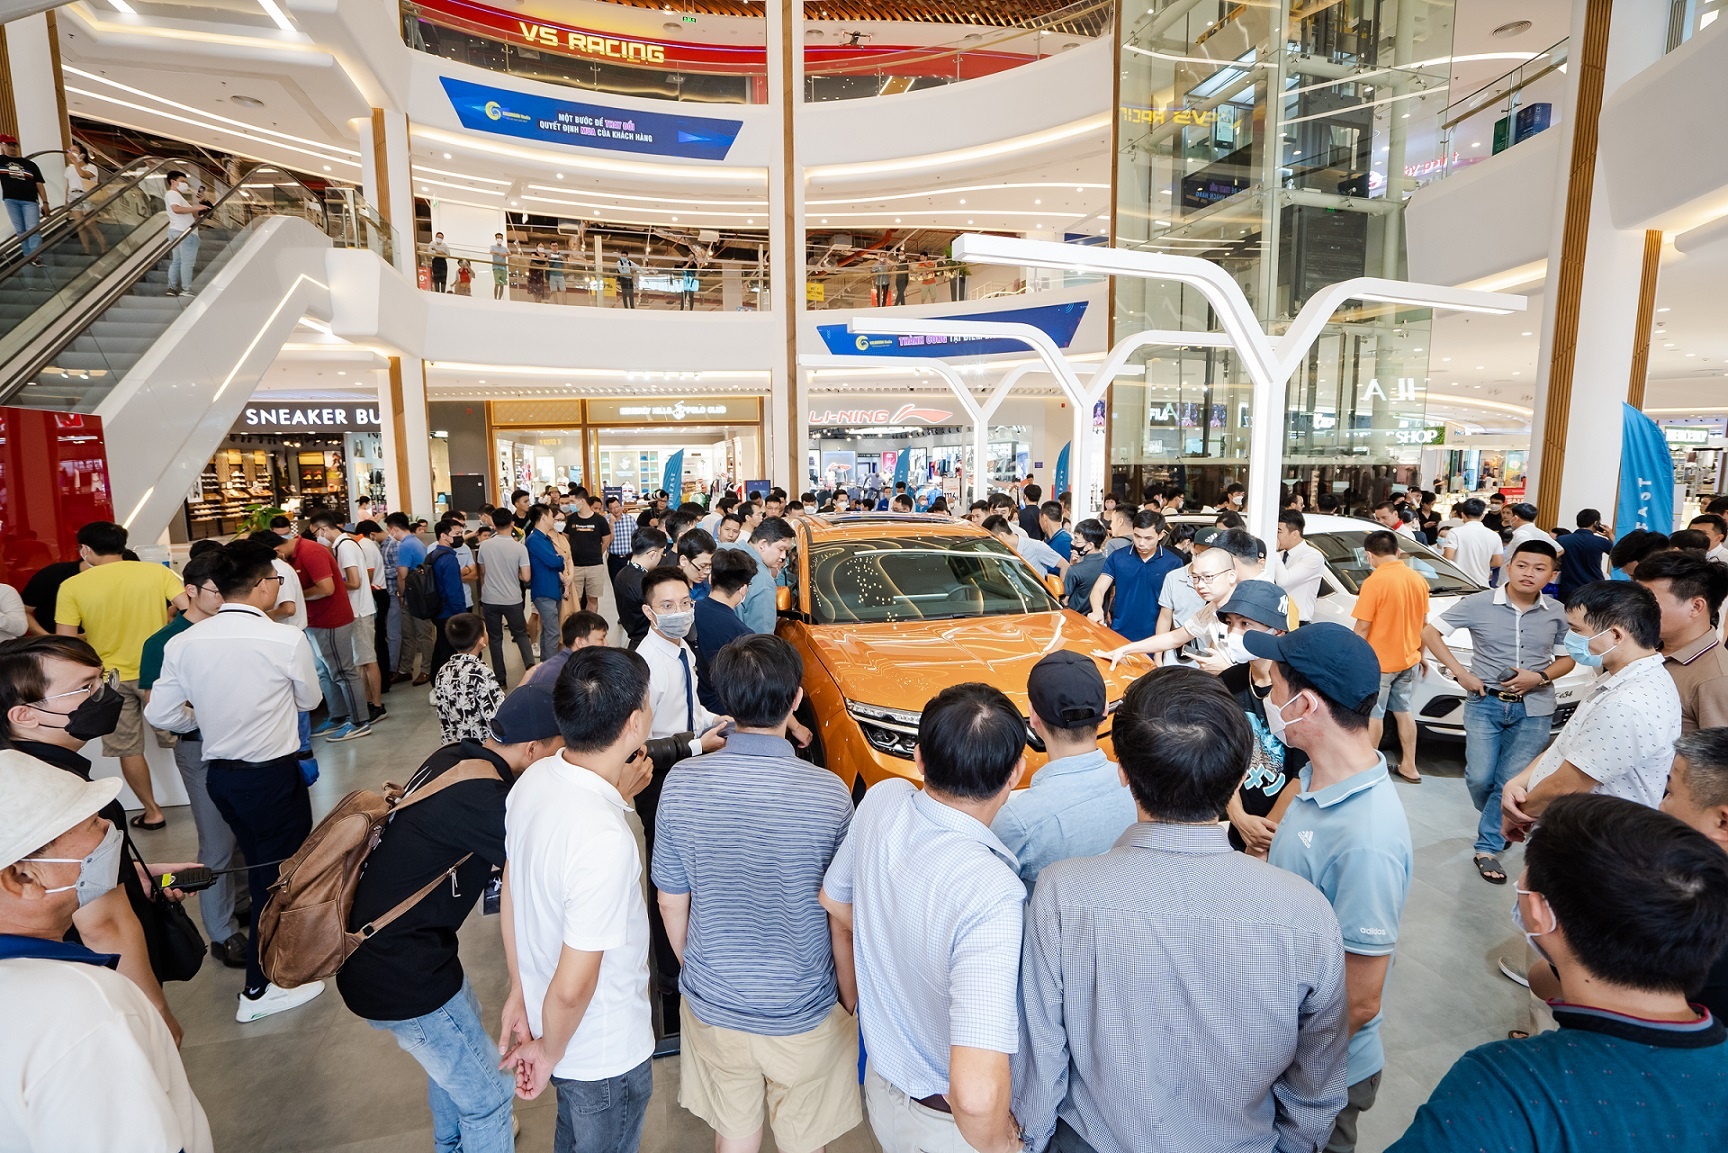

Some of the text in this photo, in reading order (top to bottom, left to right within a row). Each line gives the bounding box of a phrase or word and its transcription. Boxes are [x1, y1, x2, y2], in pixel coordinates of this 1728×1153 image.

[519, 21, 664, 63] VS RACING
[559, 113, 573, 122] MỘT
[539, 120, 561, 131] QUYẾT
[580, 126, 596, 136] MUA
[597, 128, 611, 138] CỦA
[612, 130, 634, 140] KHÁCH
[635, 132, 653, 143] HÀNG
[245, 409, 381, 425] SNEAKER BU
[809, 410, 889, 424] LI-NING
[1360, 927, 1386, 936] adidas
